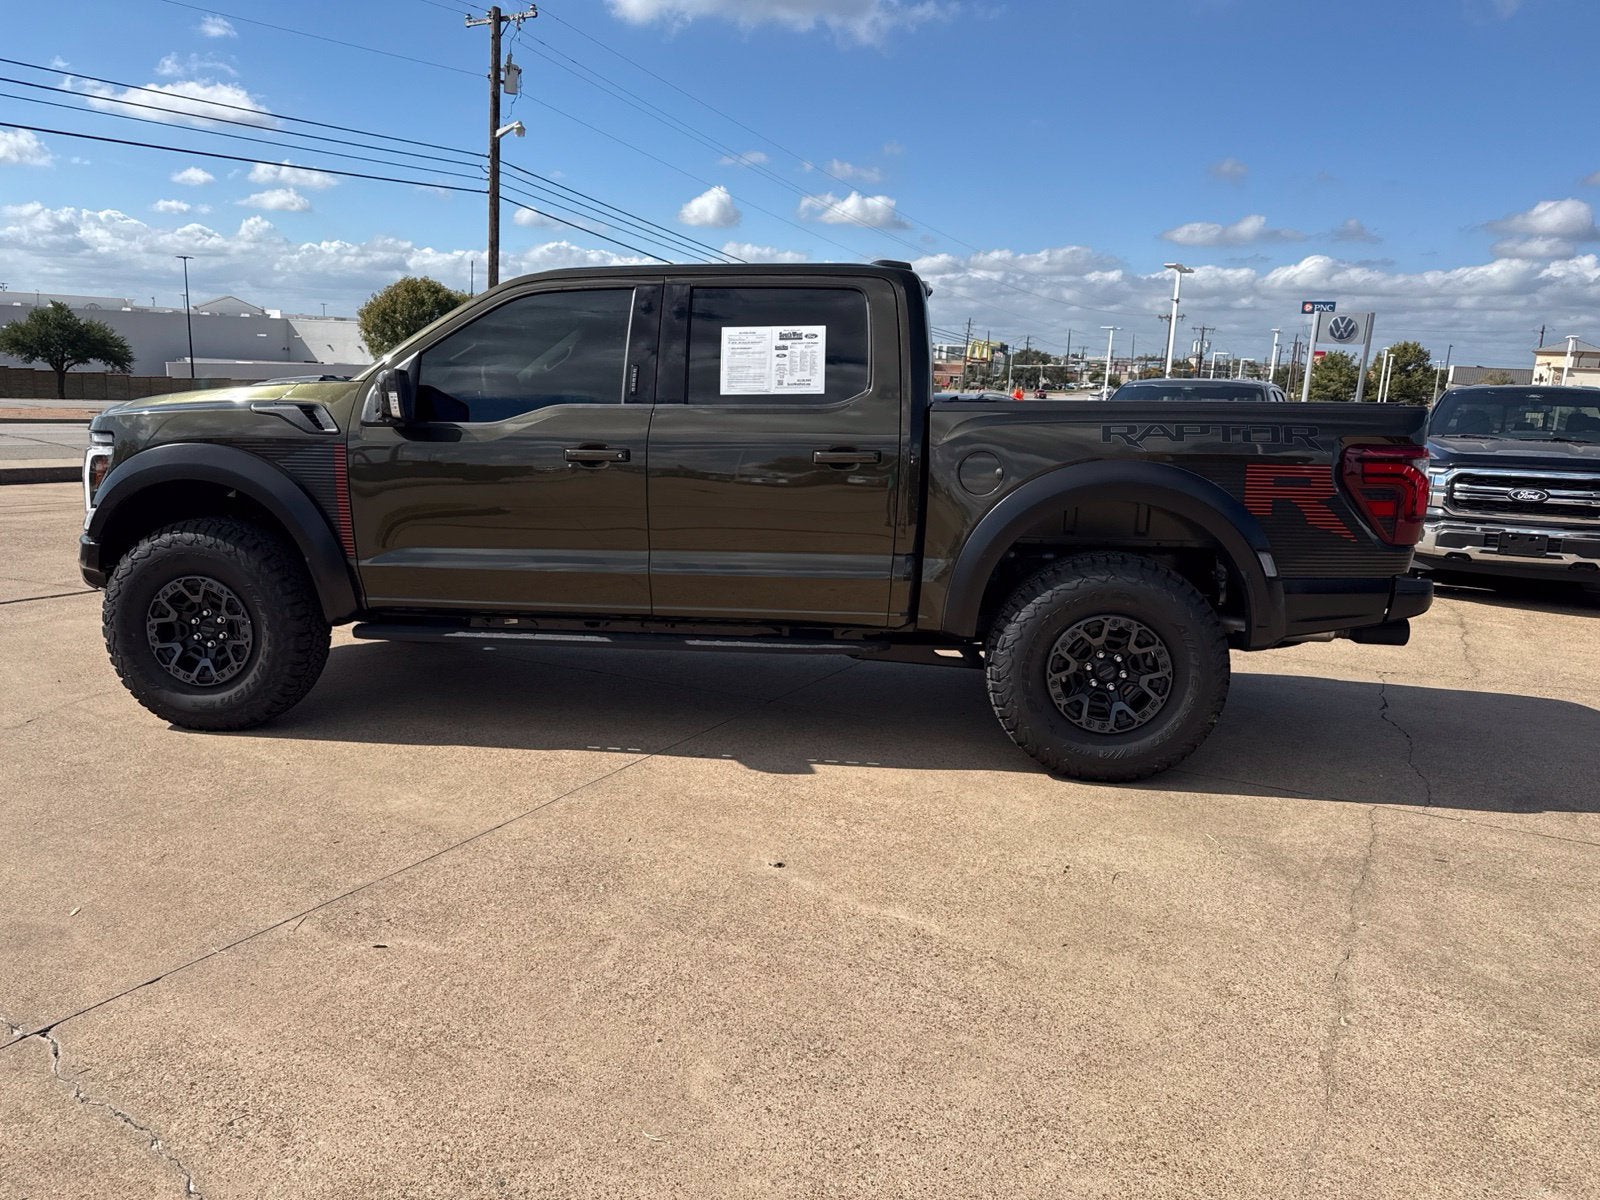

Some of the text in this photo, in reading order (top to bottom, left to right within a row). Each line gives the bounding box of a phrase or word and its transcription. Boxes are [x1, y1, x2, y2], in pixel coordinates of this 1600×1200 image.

[1314, 304, 1334, 312] PNC
[1100, 423, 1328, 455] RAPTOR
[1517, 490, 1541, 500] Ford
